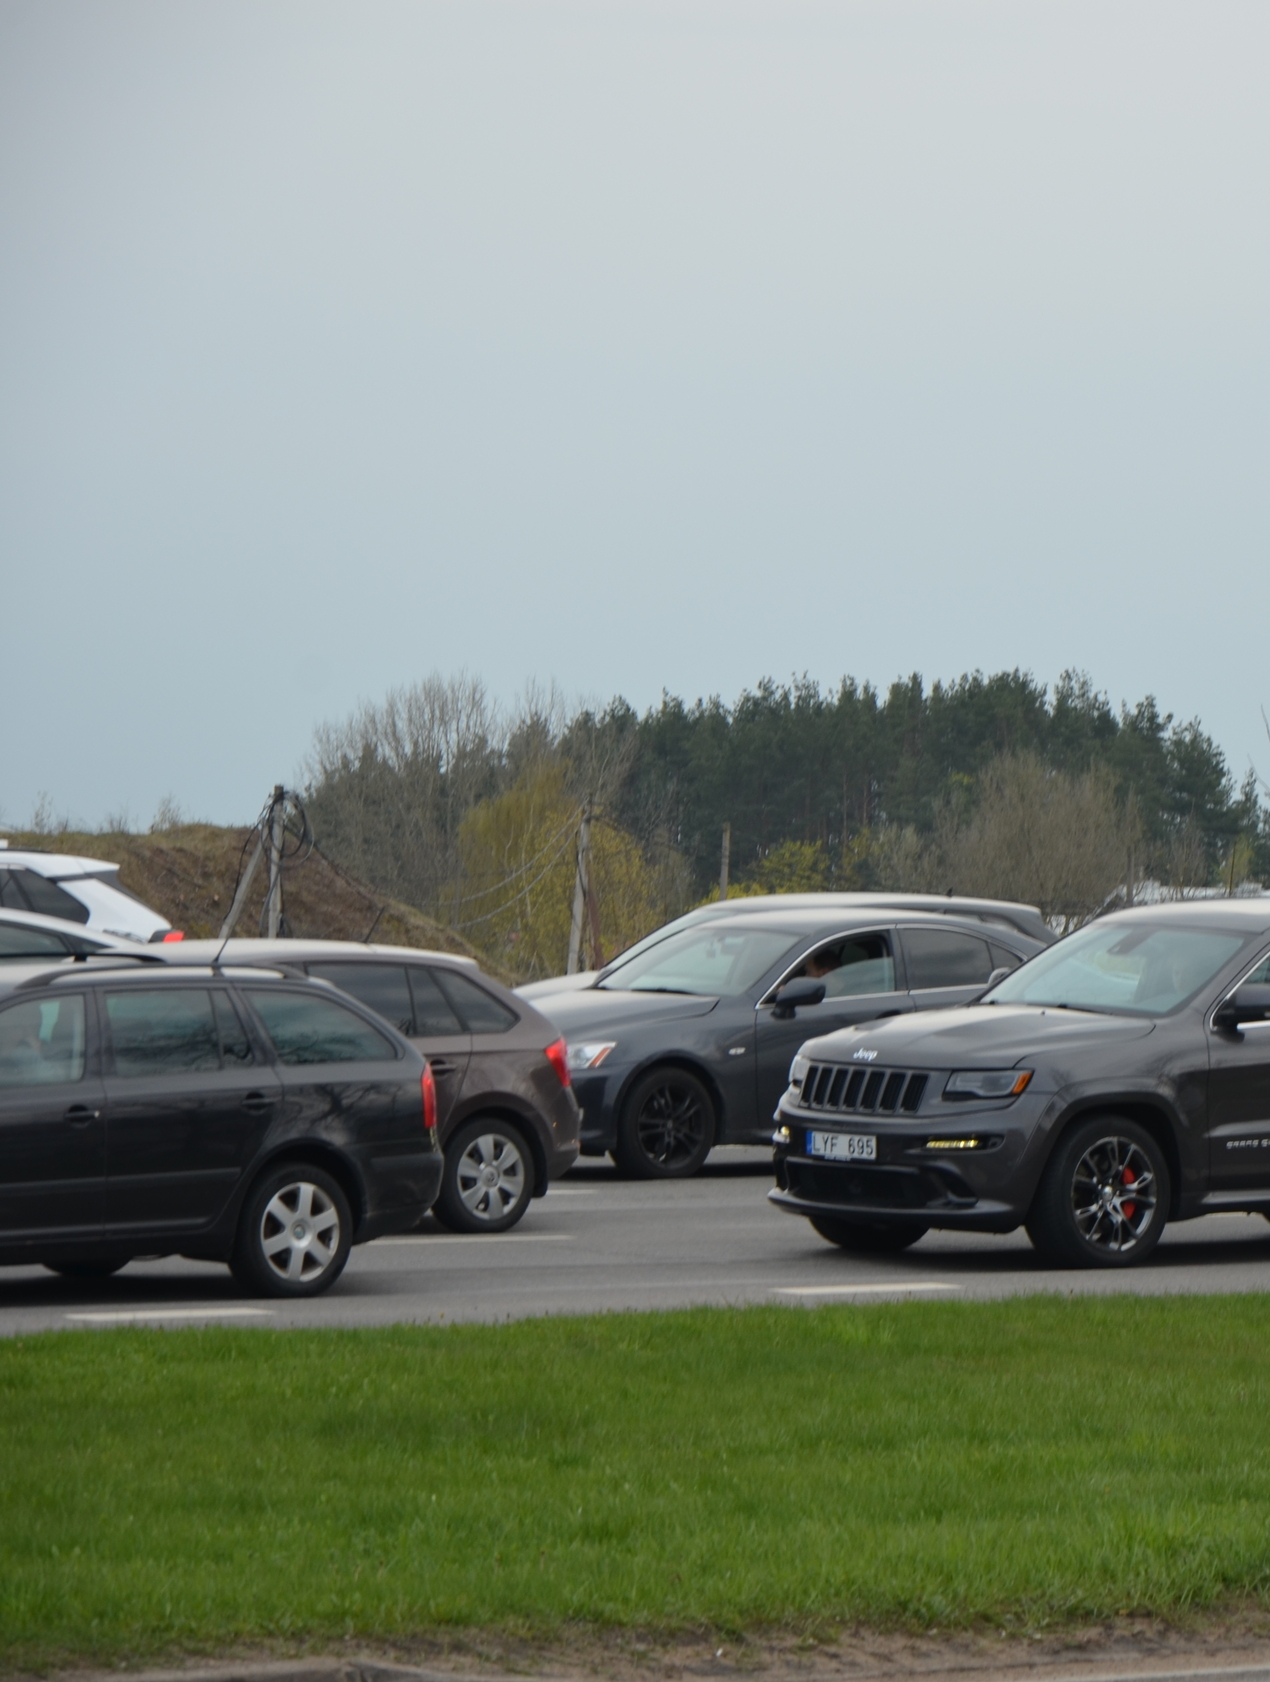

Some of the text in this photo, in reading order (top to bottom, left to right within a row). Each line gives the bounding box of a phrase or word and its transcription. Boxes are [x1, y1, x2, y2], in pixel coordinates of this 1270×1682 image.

[853, 1047, 878, 1062] Jeep
[813, 1134, 874, 1156] LYF 695
